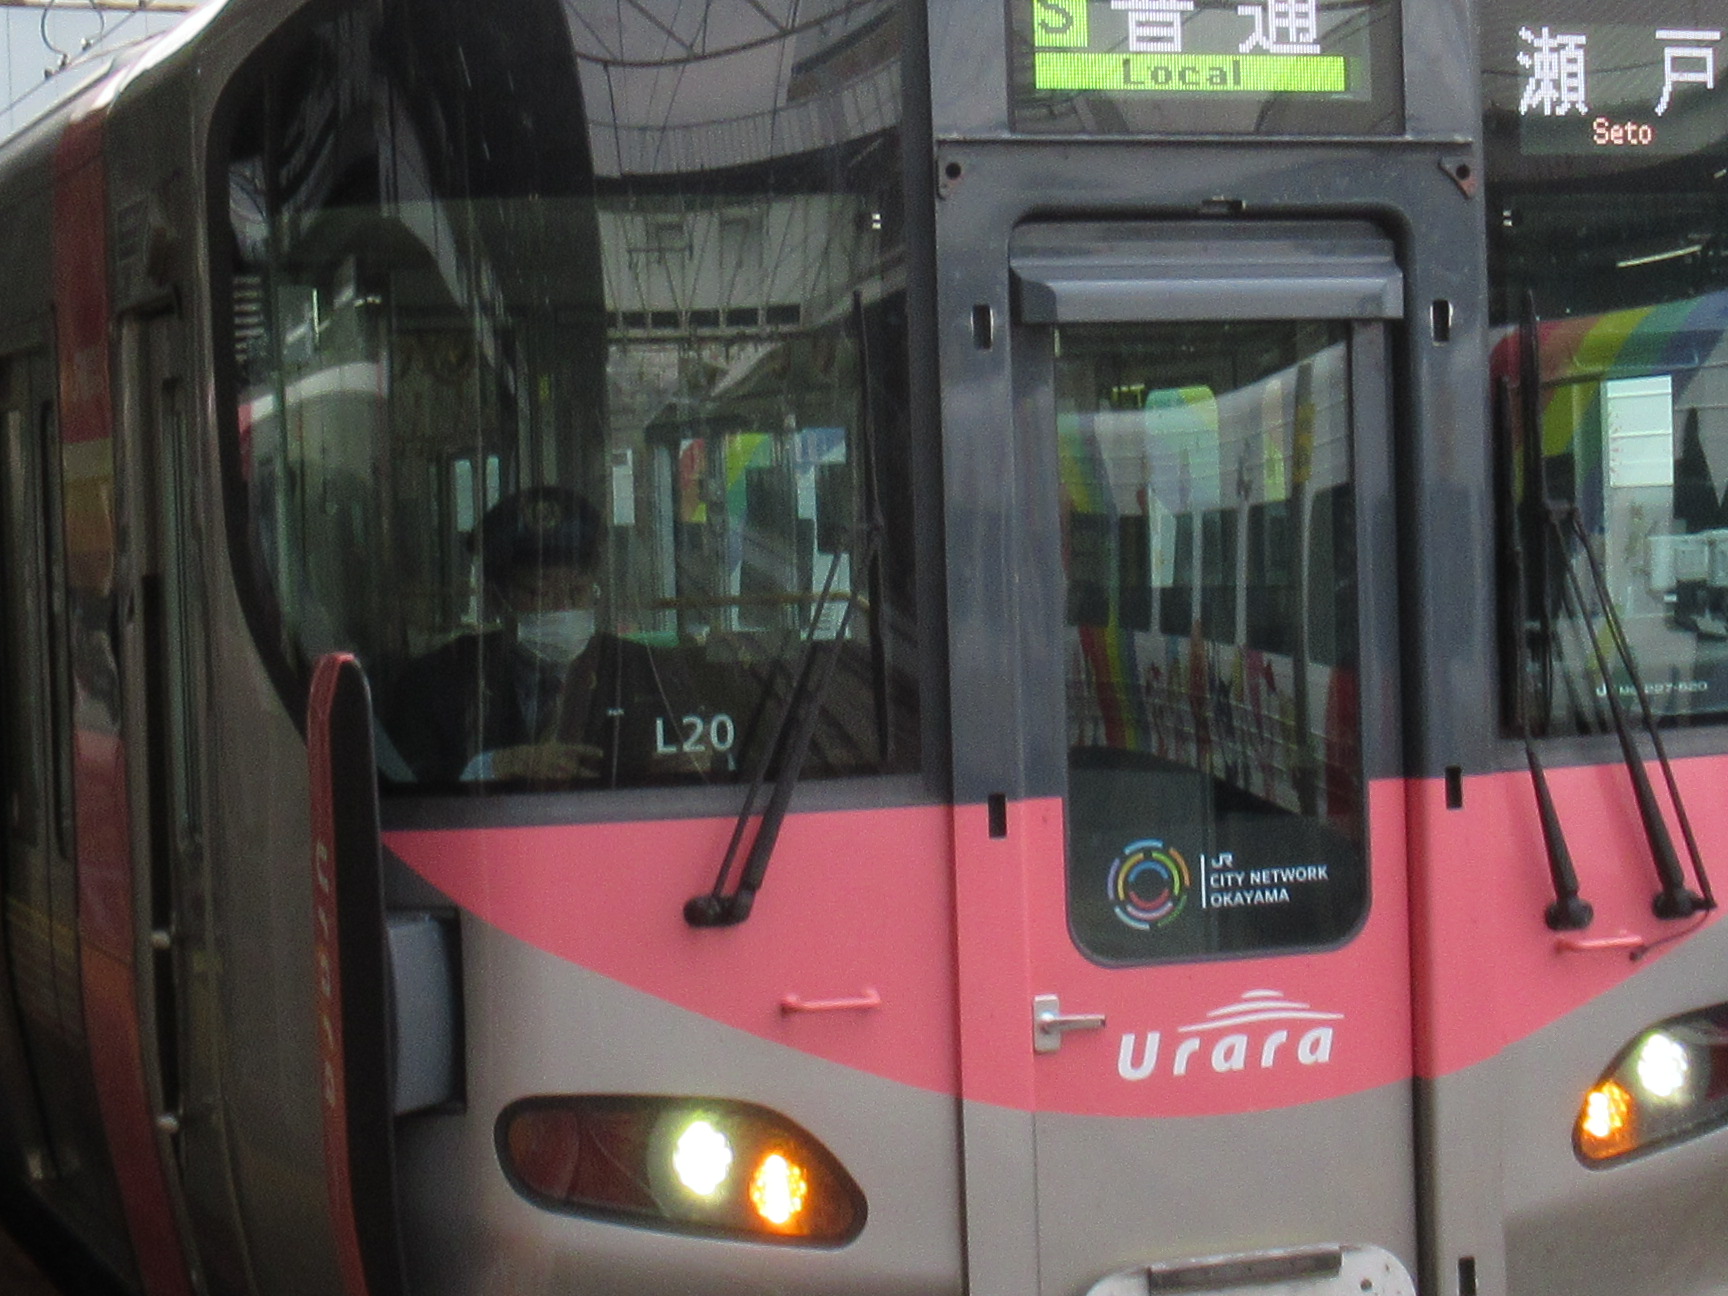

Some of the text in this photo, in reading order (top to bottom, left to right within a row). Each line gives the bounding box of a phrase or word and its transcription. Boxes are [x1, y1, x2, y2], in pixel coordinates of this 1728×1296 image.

[1122, 58, 1241, 87] Local
[1516, 25, 1721, 117] 瀬戸
[1592, 116, 1654, 145] Seto
[656, 712, 735, 753] L20
[1210, 852, 1234, 869] JR
[1210, 864, 1330, 889] CITY NETWORK
[1210, 887, 1291, 909] OKAYAMA
[1118, 1026, 1334, 1082] Urara
